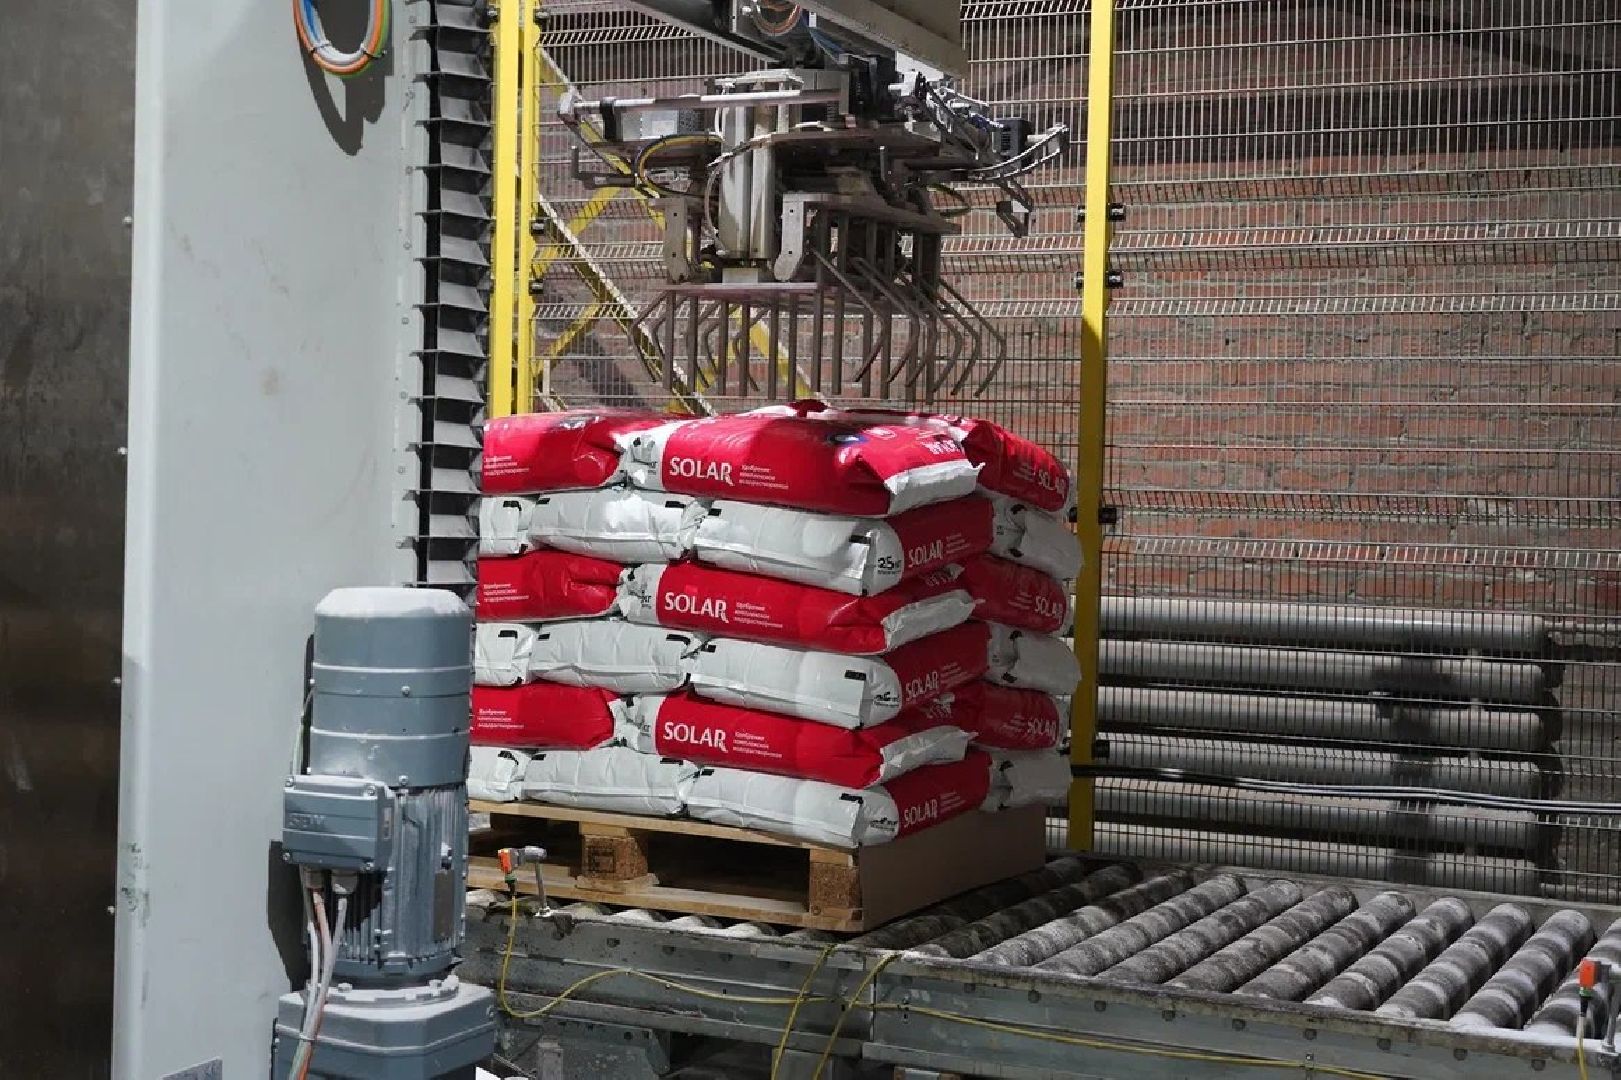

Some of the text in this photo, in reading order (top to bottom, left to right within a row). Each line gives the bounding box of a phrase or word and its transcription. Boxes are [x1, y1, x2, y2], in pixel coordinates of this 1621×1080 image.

[669, 456, 735, 487] SOLAR
[908, 539, 944, 568] SOLAR
[664, 592, 730, 624] SOLAR
[905, 671, 939, 702] SOLAR
[663, 721, 729, 753] SOLAR
[904, 798, 938, 829] SOLAR
